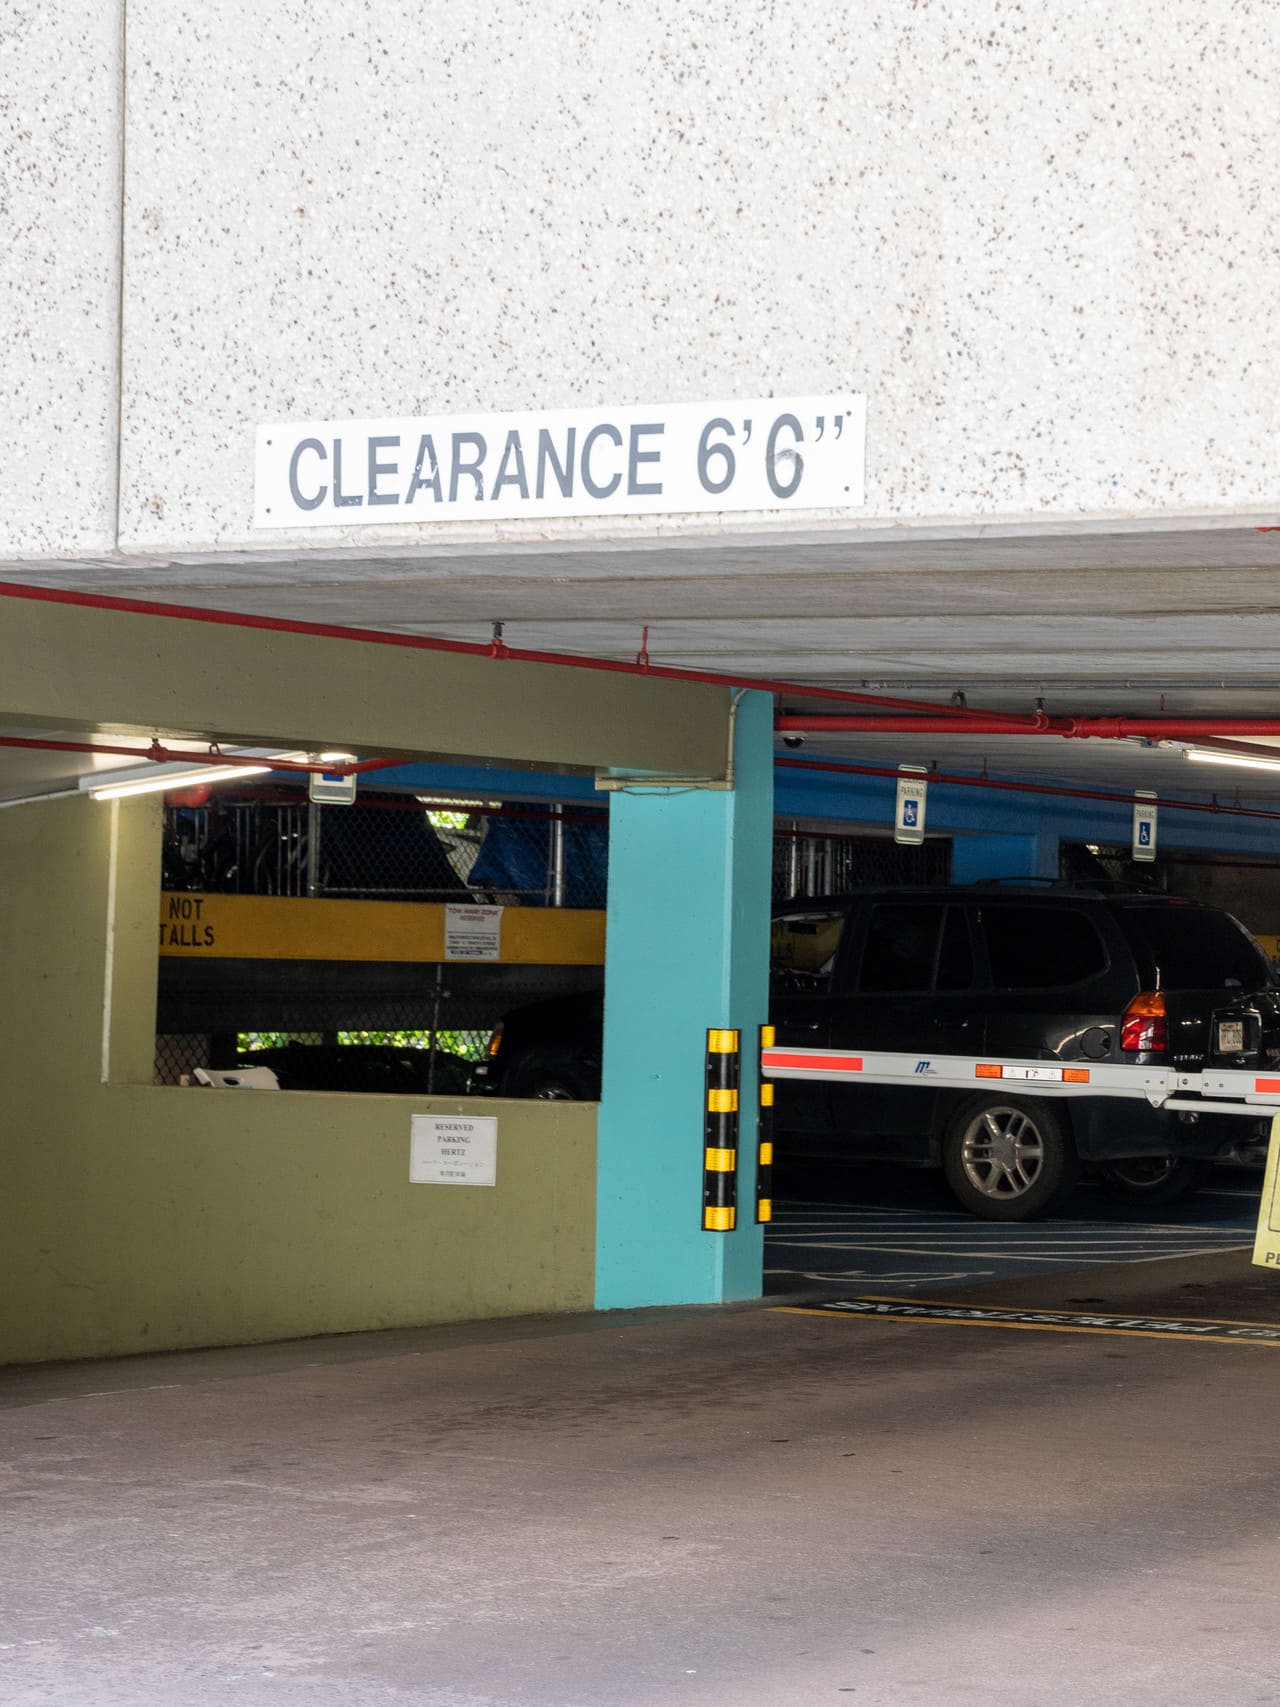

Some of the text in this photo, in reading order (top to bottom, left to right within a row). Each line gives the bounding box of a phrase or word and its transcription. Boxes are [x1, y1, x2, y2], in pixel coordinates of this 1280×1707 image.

[289, 423, 665, 511] CLEARANCE
[169, 897, 204, 920] NOT
[160, 923, 214, 946] TALLS
[435, 1123, 475, 1131] RESERVED
